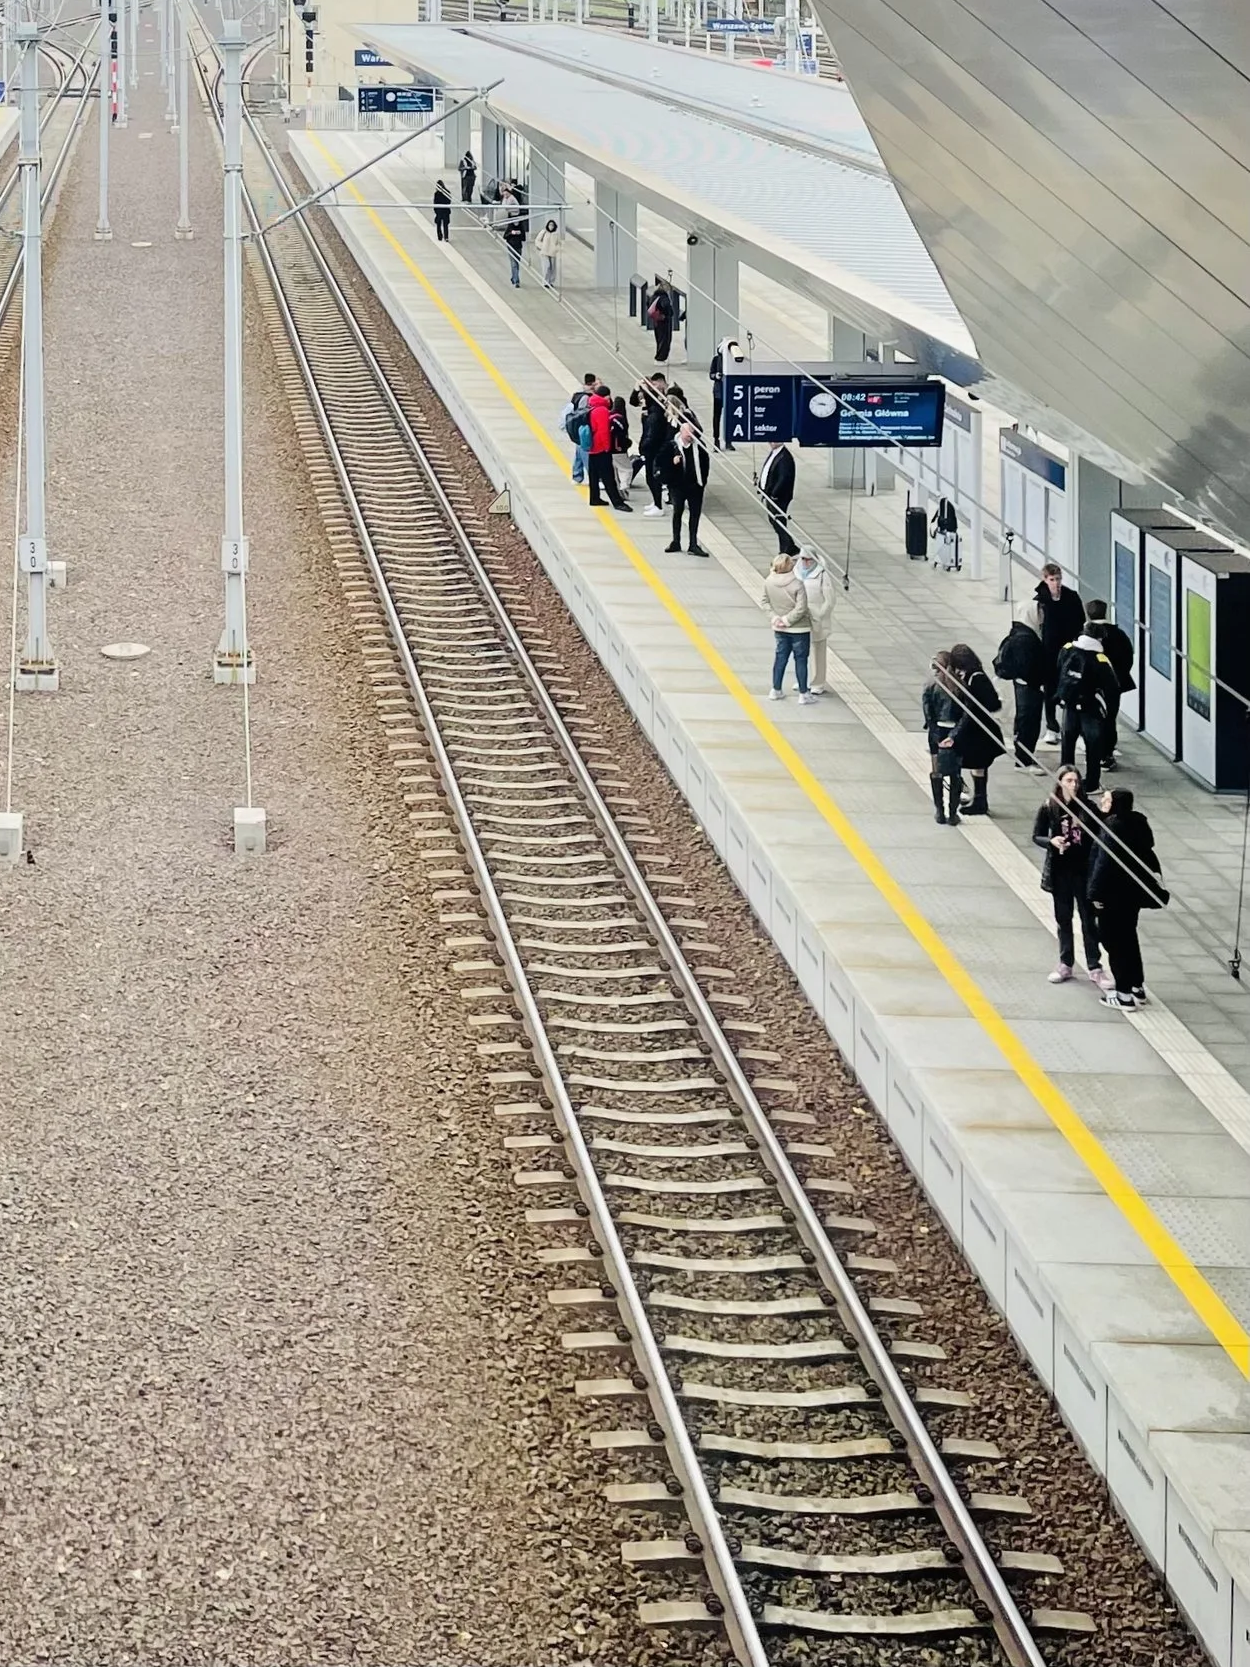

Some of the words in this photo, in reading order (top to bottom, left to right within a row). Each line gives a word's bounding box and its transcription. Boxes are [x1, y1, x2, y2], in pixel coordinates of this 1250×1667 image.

[733, 385, 744, 400] 5
[754, 386, 780, 395] peron
[734, 406, 744, 418] 4
[874, 409, 910, 417] Główna
[733, 424, 744, 436] A
